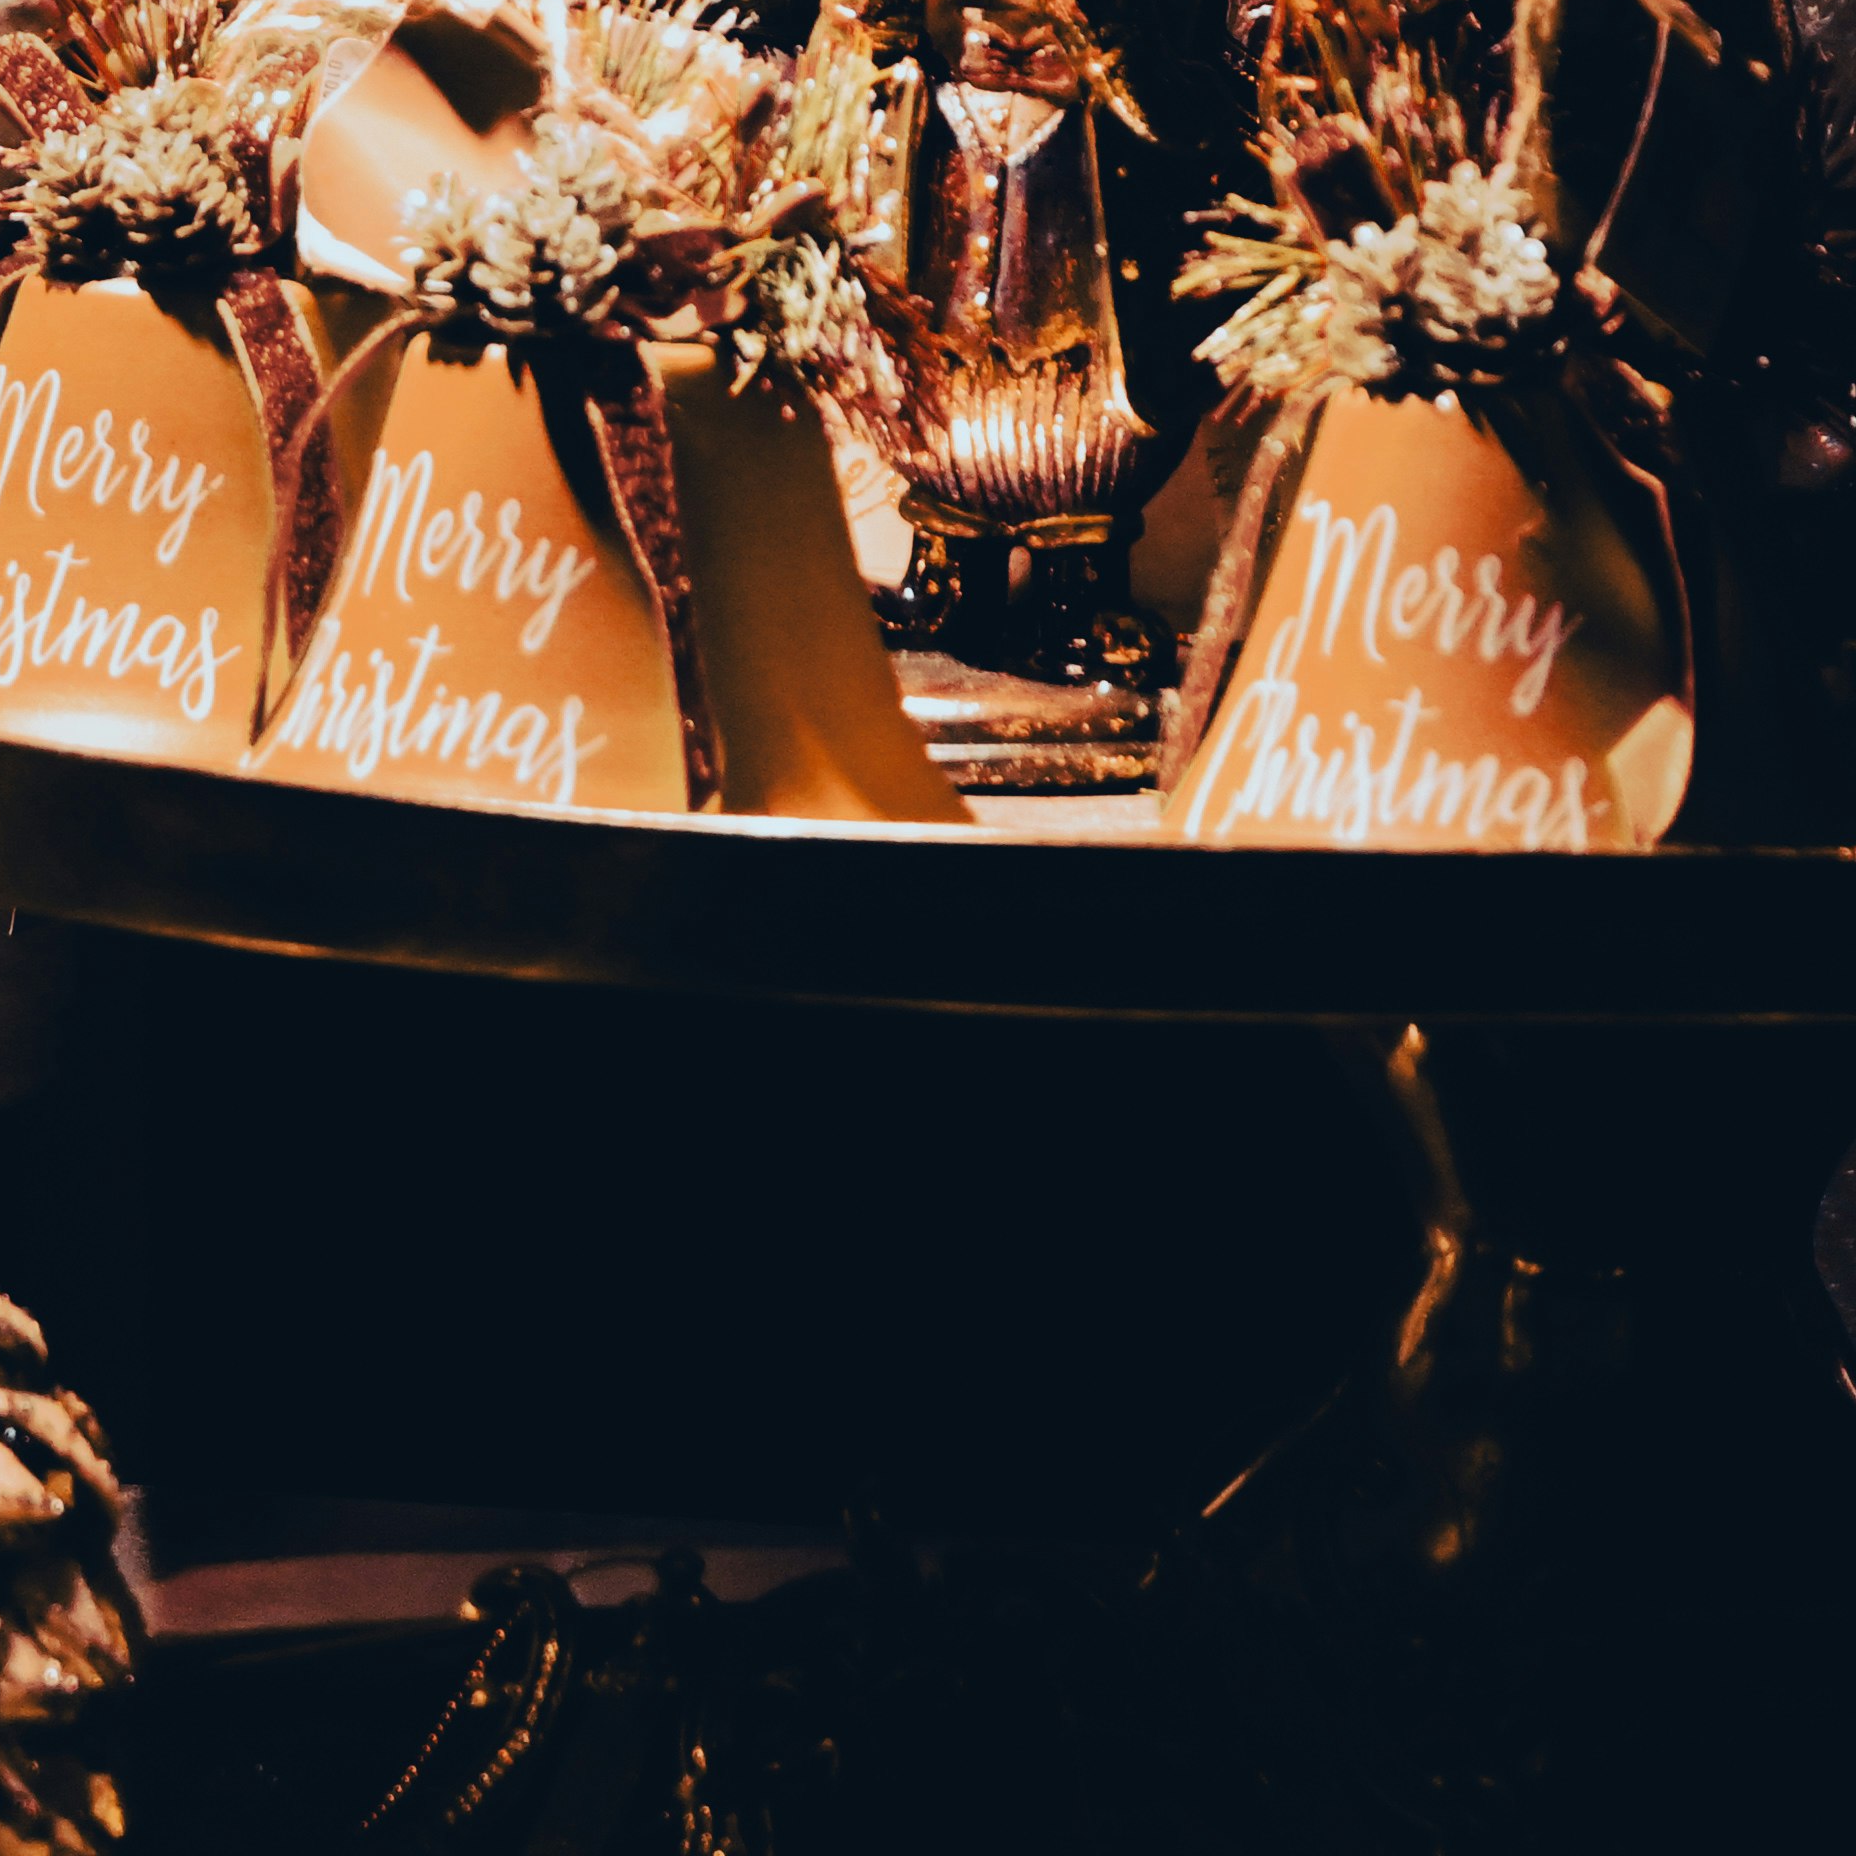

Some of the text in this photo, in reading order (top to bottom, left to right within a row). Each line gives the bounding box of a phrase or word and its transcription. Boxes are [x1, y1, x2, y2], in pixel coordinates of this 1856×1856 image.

[342, 447, 597, 652] Merry
[1265, 491, 1584, 717] Merry
[242, 616, 608, 805] hristmas
[1183, 680, 1612, 854] Christmas
